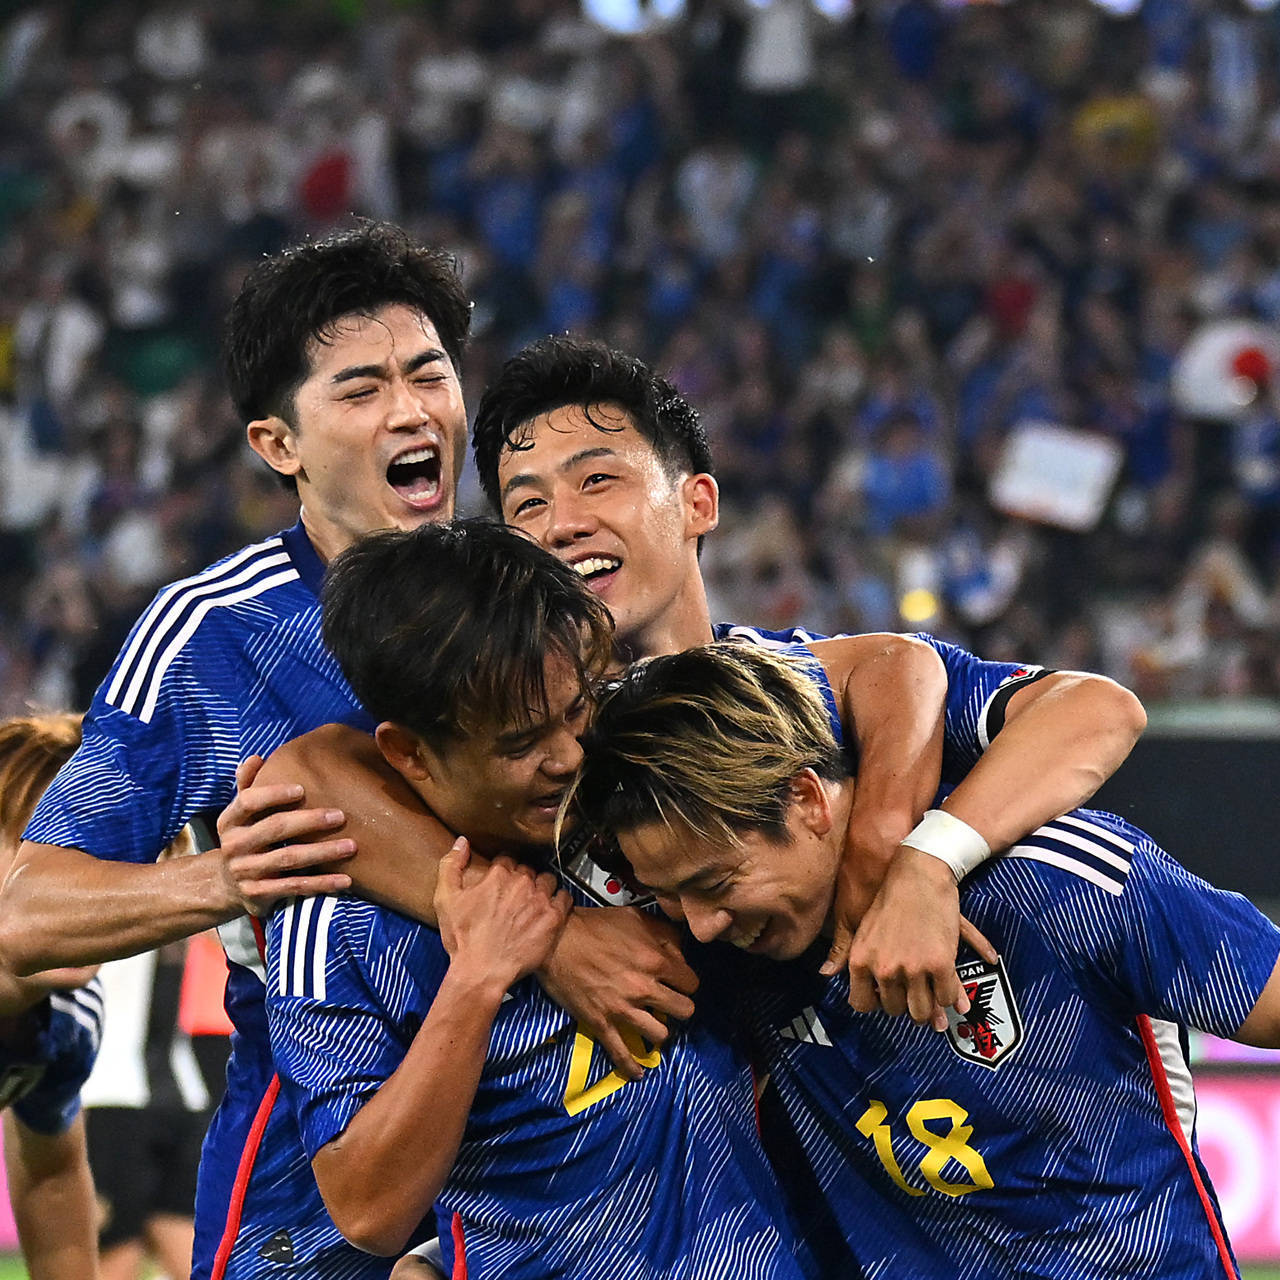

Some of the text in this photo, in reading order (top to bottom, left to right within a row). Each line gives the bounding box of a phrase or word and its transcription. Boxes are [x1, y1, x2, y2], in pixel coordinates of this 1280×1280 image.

[960, 965, 985, 978] PAN
[971, 1032, 1004, 1054] JFA
[855, 1099, 995, 1197] 18
